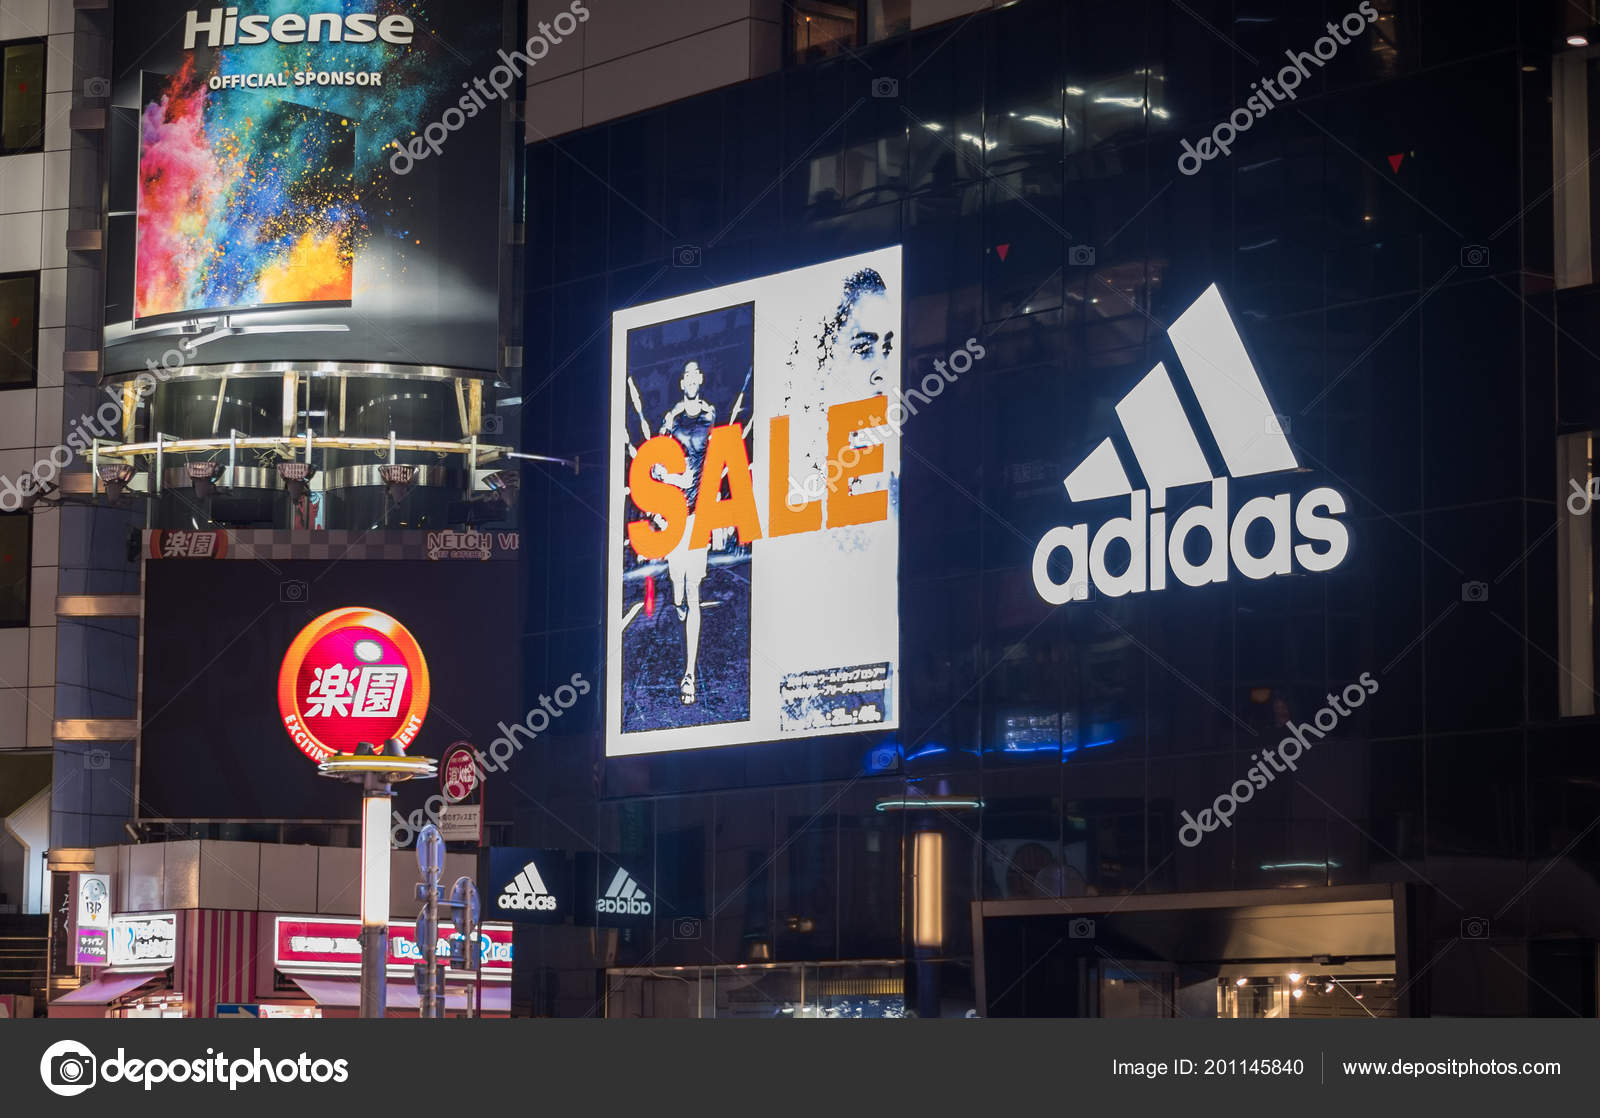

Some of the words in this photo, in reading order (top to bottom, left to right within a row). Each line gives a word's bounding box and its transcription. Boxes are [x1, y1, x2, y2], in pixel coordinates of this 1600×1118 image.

[184, 7, 414, 49] Hisense
[209, 73, 287, 89] OFFICIAL
[294, 72, 382, 87] SPONSOR
[628, 395, 888, 559] SALE
[163, 531, 216, 557] 楽園
[427, 530, 492, 549] NETCH
[1032, 477, 1349, 605] adidas
[303, 663, 408, 717] 楽園
[498, 889, 556, 911] adidas
